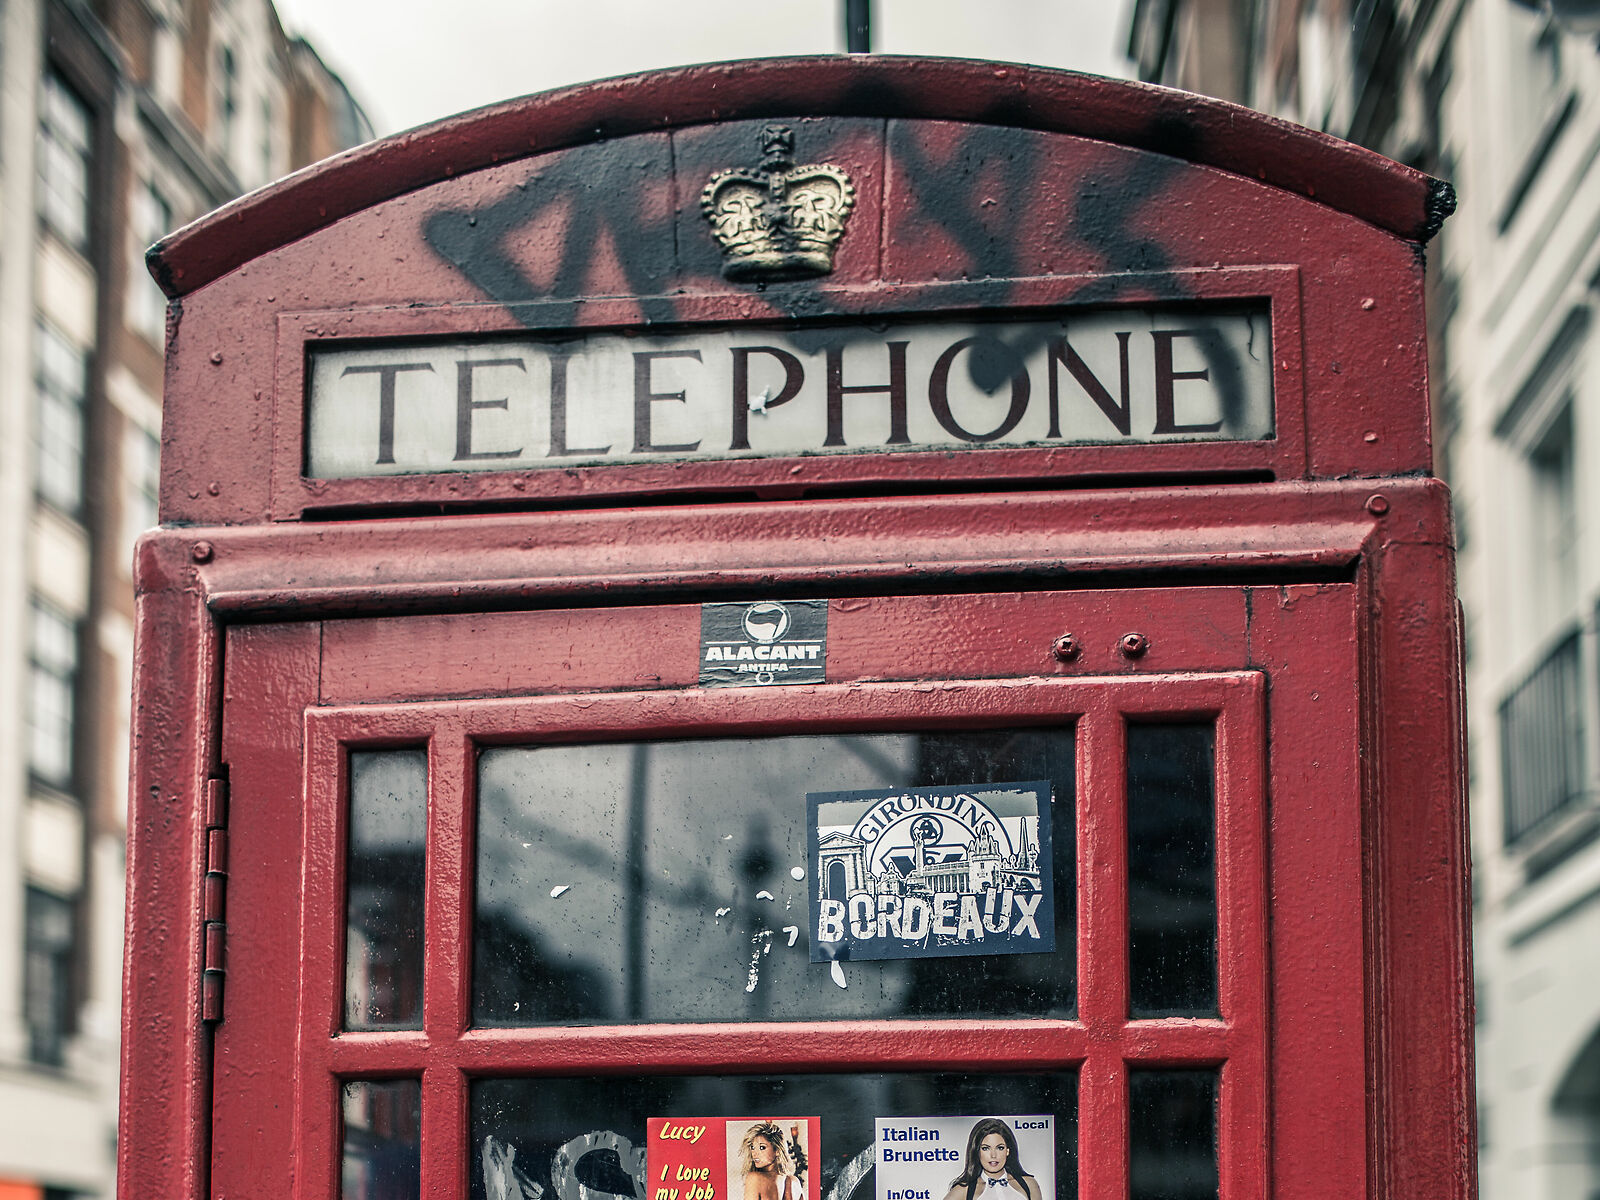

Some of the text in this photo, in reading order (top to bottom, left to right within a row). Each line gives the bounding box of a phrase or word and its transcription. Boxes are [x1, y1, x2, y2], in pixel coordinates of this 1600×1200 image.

[339, 329, 1224, 466] TELEPHONE
[705, 645, 821, 661] ALACANT
[738, 663, 789, 672] ANTIFA
[858, 795, 997, 845] GIRONDINS
[818, 886, 1044, 944] BORDEAUX
[659, 1121, 706, 1145] Lucy
[1014, 1119, 1049, 1130] Local
[882, 1126, 940, 1142] Italian
[883, 1148, 960, 1163] Brunette
[660, 1163, 710, 1182] I Love
[685, 1182, 716, 1200] Job
[887, 1188, 930, 1200] In/Out
